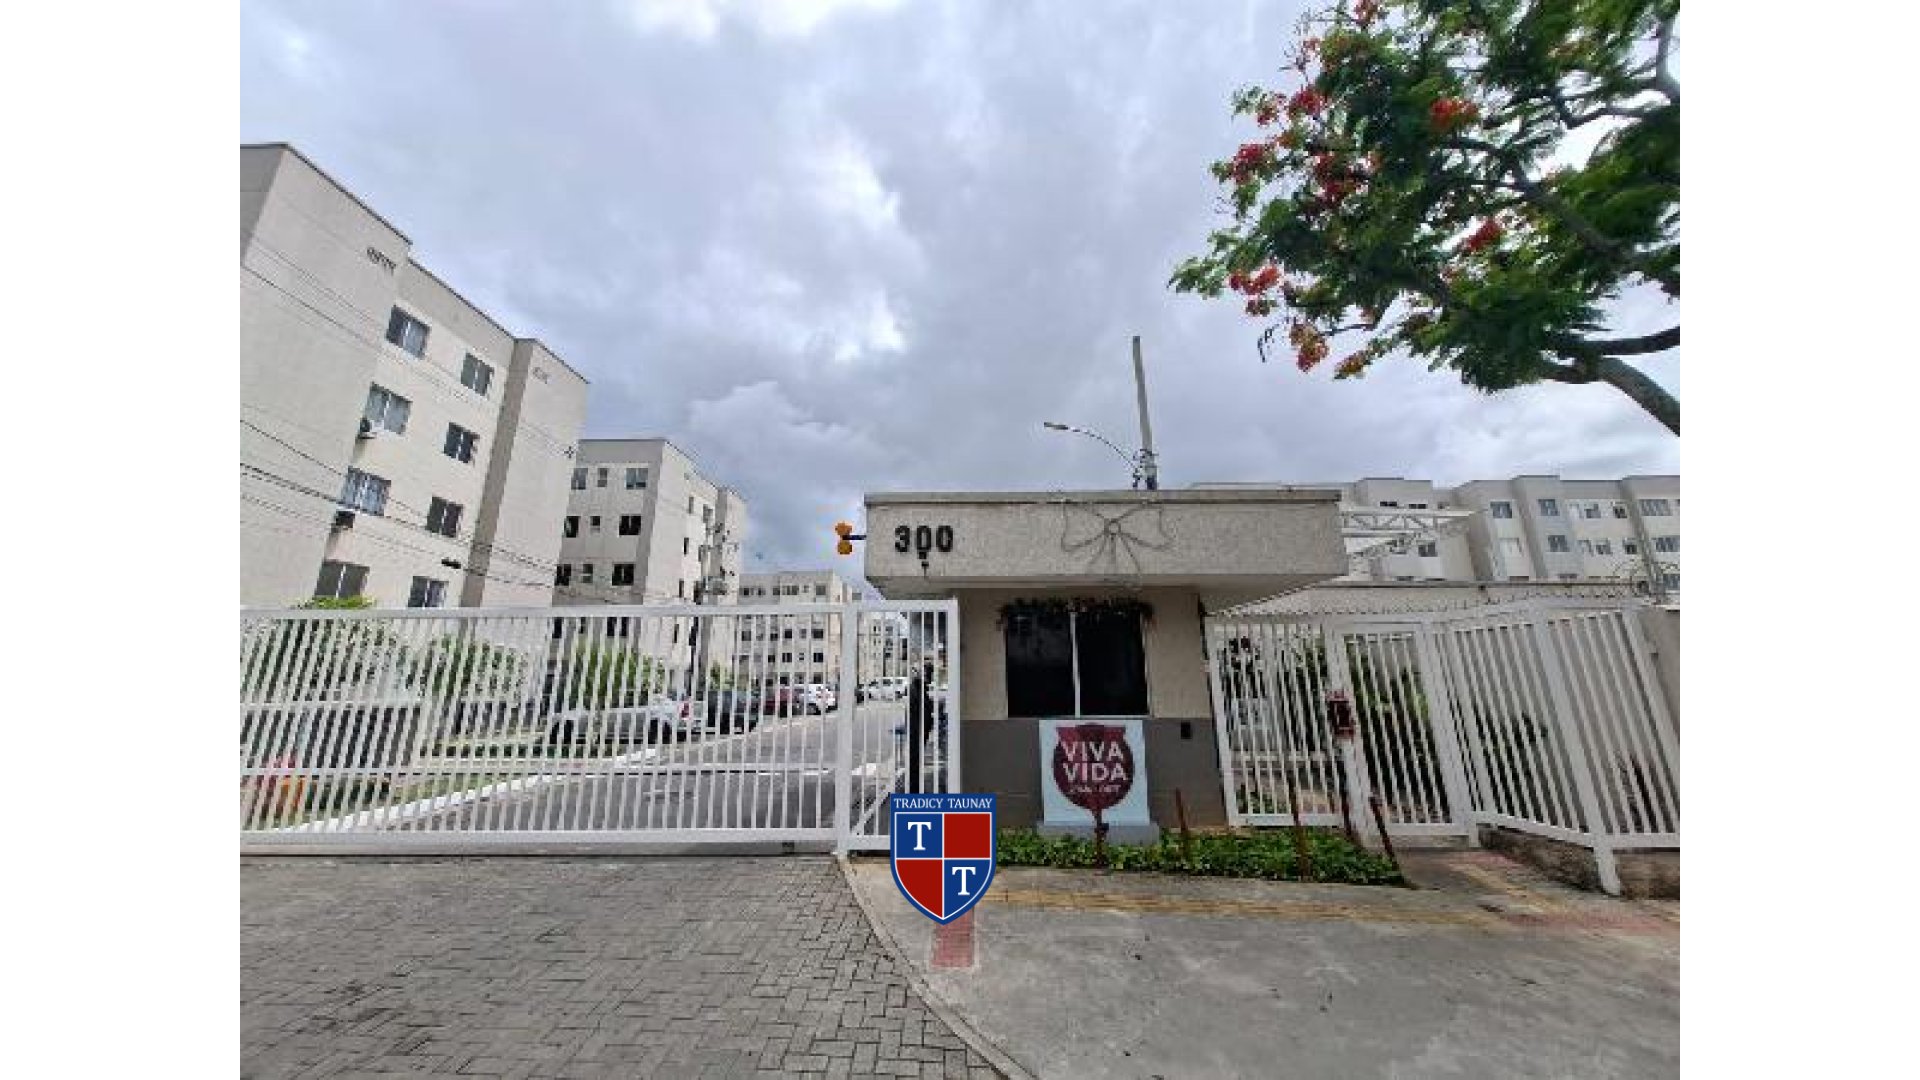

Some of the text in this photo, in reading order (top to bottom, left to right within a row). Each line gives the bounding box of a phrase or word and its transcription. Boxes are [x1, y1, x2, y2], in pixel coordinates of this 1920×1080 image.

[894, 525, 954, 553] 300
[1060, 740, 1124, 762] VIVA
[1062, 762, 1127, 782] VIDA
